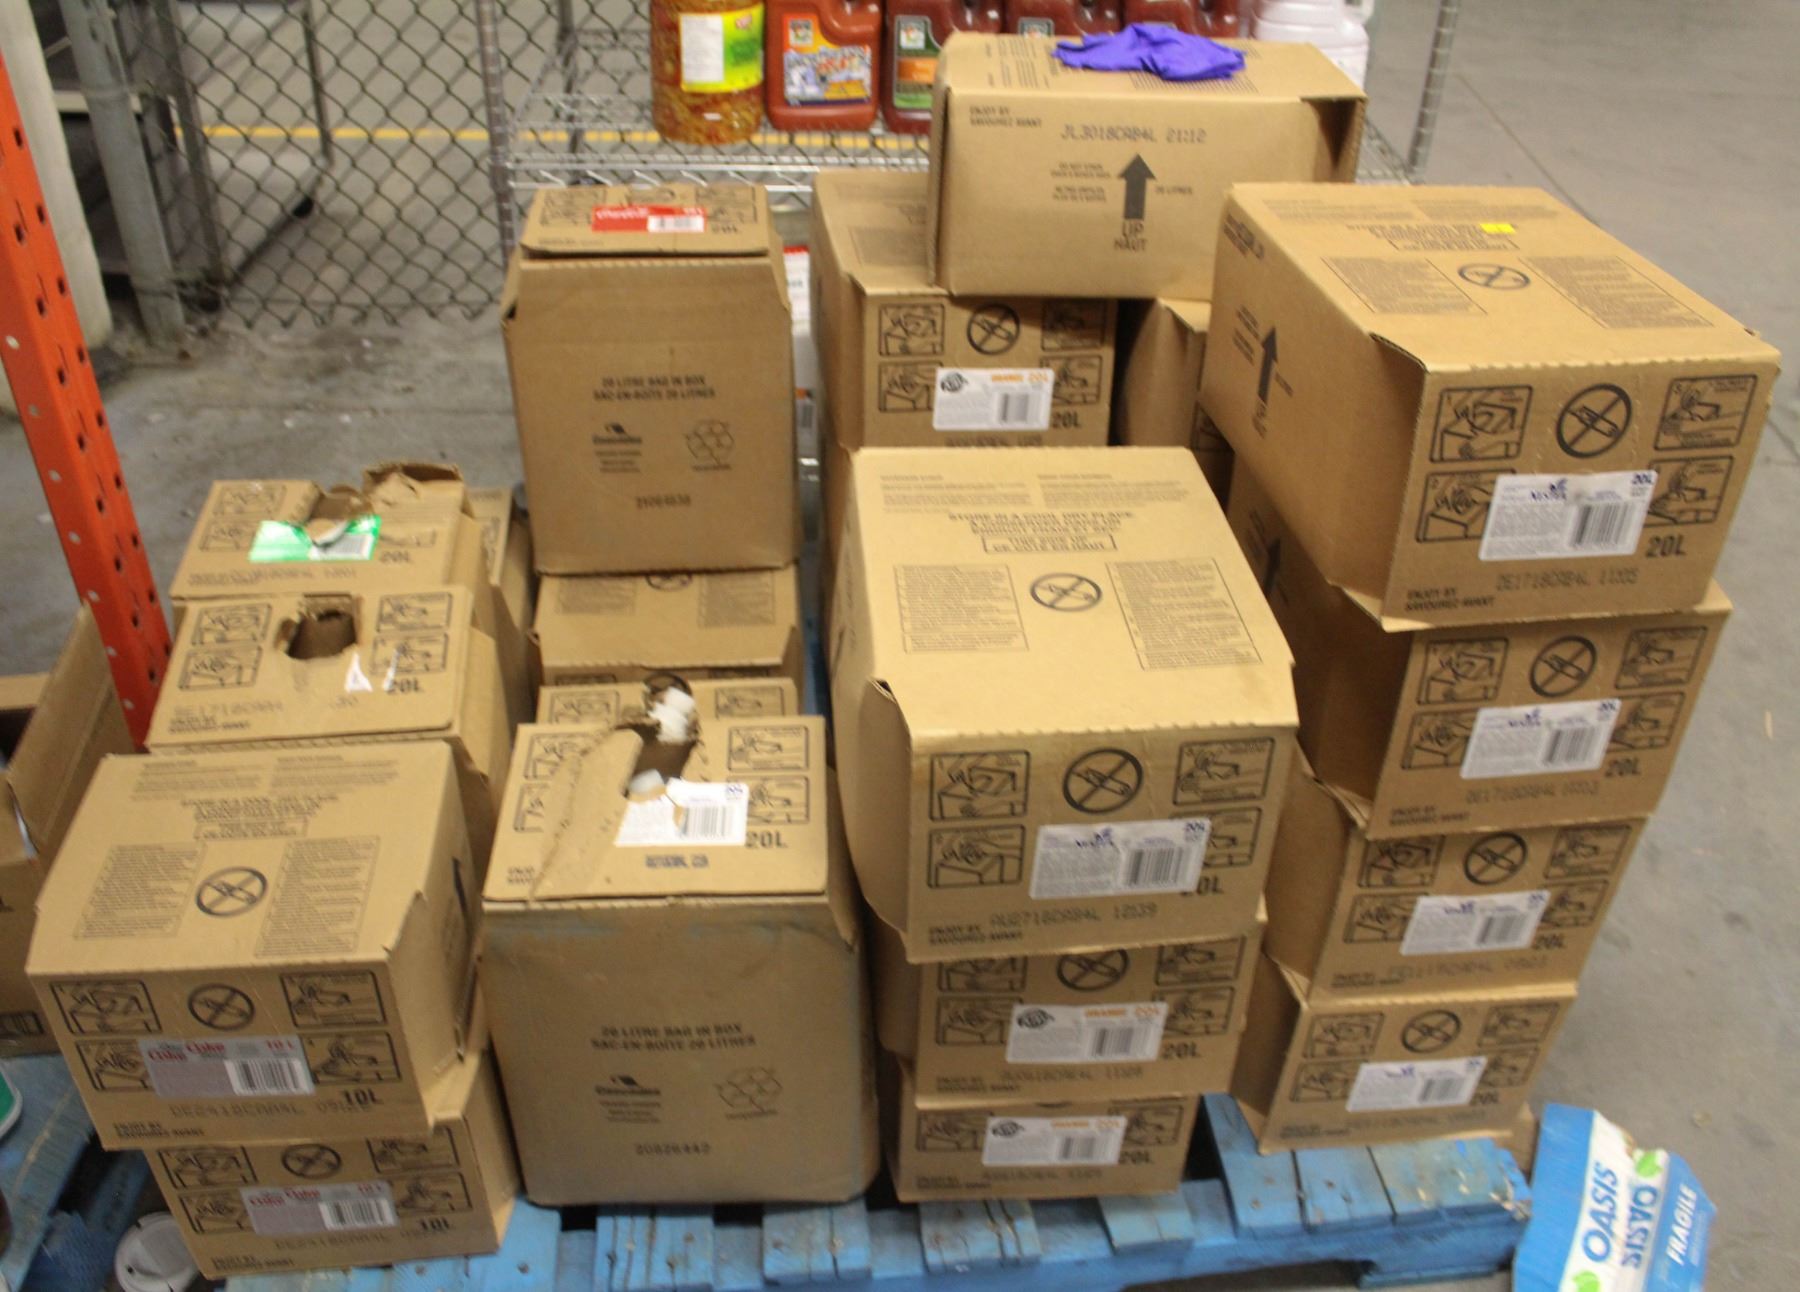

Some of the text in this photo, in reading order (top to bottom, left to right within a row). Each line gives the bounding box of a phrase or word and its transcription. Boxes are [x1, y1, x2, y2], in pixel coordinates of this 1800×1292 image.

[1121, 222, 1144, 237] UP
[1646, 535, 1686, 558] 20L
[744, 831, 788, 848] 20L
[1180, 875, 1224, 897] 0L
[1582, 1162, 1618, 1263] OASIS
[1620, 1184, 1659, 1270] OASIS
[1665, 1183, 1698, 1267] FRAGILE
